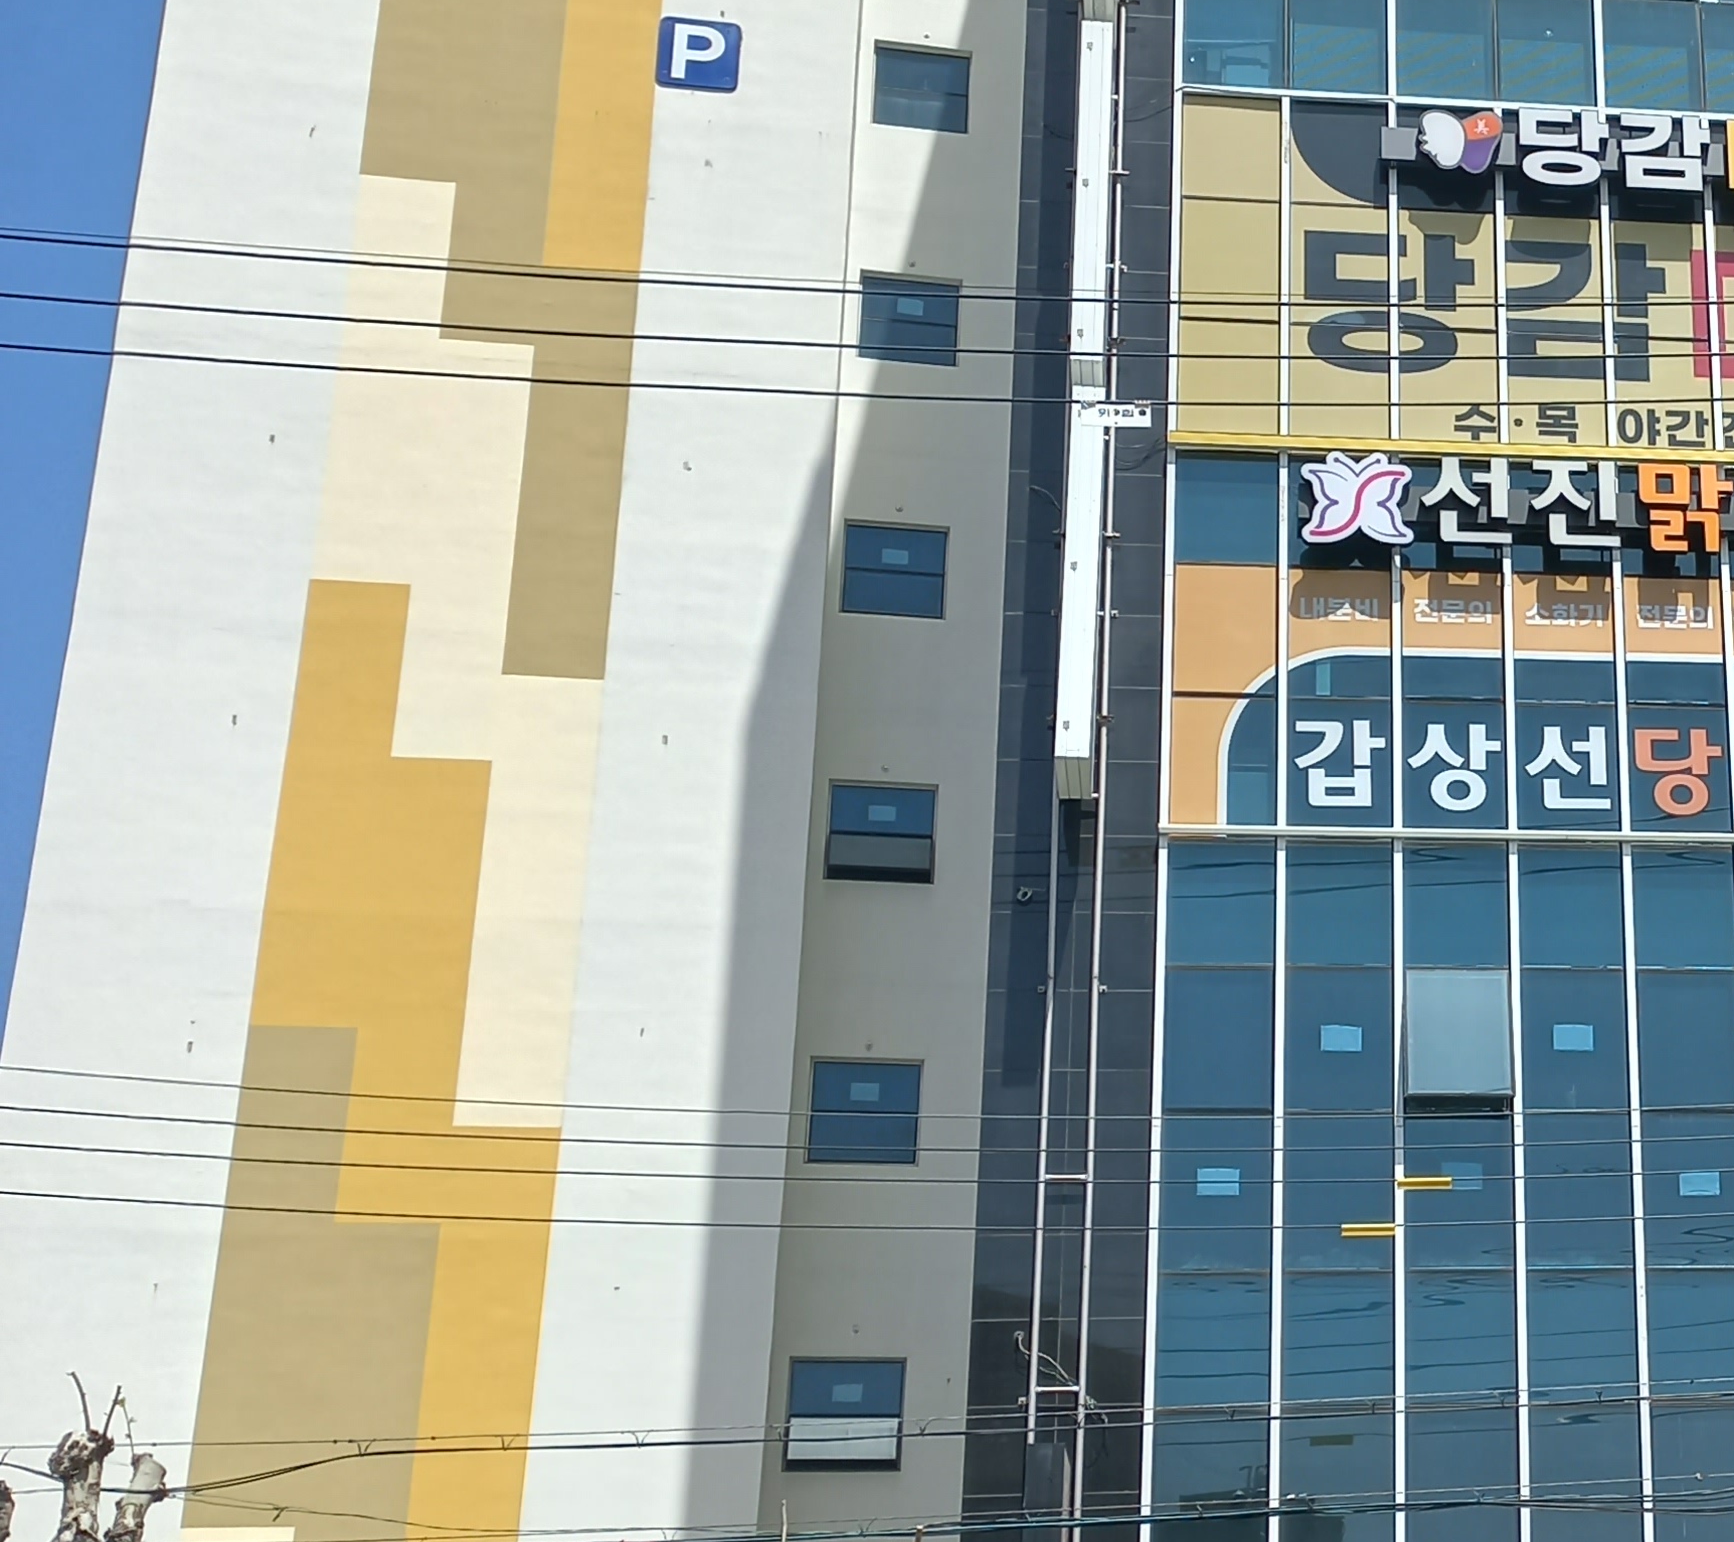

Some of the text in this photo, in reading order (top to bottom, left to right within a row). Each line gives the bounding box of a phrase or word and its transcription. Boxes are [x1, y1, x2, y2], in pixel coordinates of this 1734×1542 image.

[670, 23, 726, 79] P
[1299, 596, 1379, 623] 내분비
[1413, 598, 1493, 624] 전문의
[1525, 601, 1604, 628] 소화기
[1636, 604, 1714, 630] 전문의
[1294, 719, 1613, 813] 갑상선
